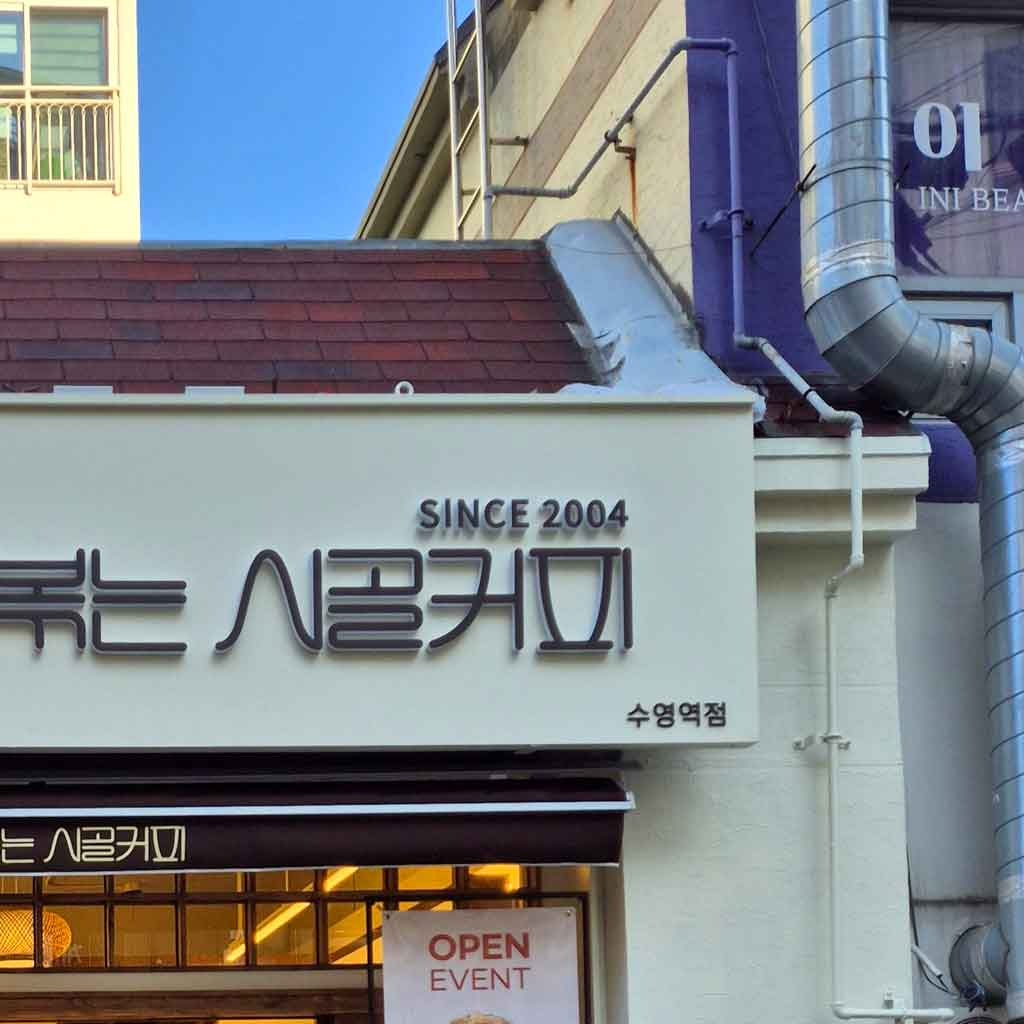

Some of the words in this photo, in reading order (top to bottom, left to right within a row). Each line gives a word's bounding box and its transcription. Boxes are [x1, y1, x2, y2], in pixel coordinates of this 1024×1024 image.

[920, 187, 960, 211] INI
[418, 498, 530, 530] SINCE
[542, 498, 630, 530] 2004
[215, 546, 634, 653] 시골커피
[626, 701, 728, 729] 수영역점
[428, 932, 531, 961] OPEN
[430, 967, 532, 992] EVENT
